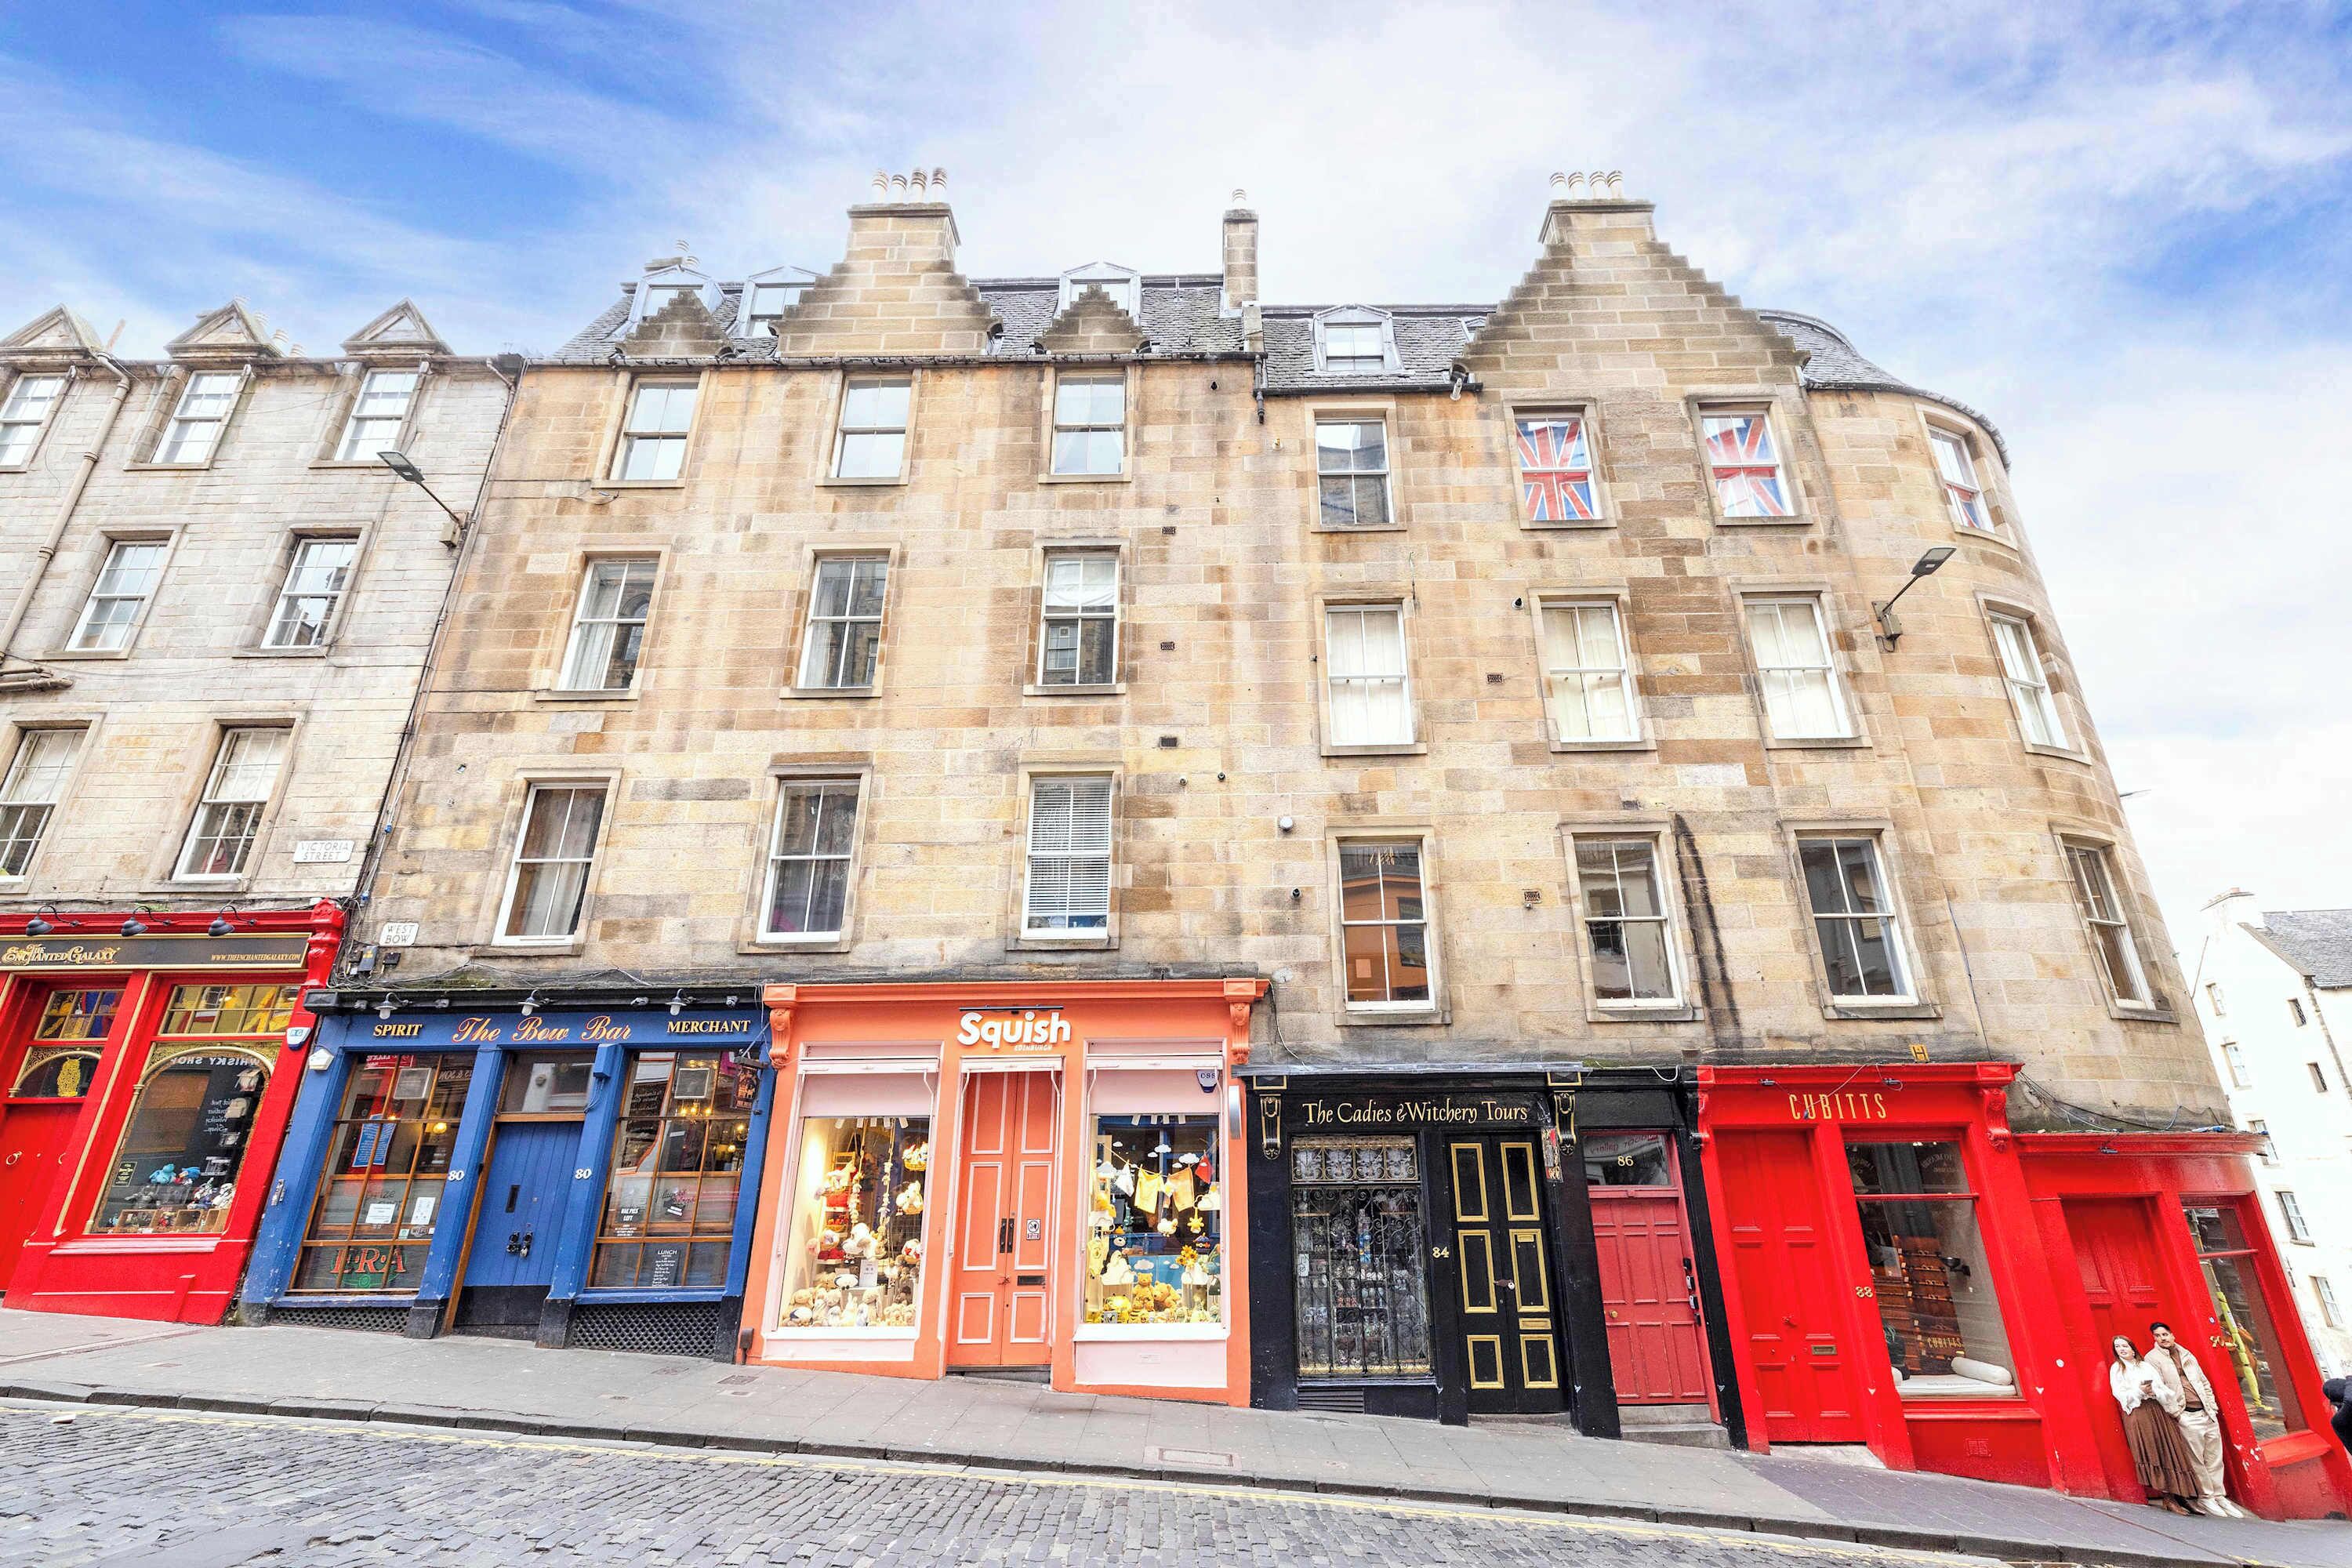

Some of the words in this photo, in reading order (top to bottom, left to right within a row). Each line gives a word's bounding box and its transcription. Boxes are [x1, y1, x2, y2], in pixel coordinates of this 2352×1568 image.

[300, 841, 350, 851] VICTORIA
[303, 851, 341, 860] STREET
[388, 924, 416, 934] WEST
[385, 935, 410, 944] BOW
[372, 1024, 423, 1036] SPIRIT
[452, 1017, 502, 1043] The
[512, 1016, 570, 1042] Bow
[580, 1015, 633, 1041] Bar
[666, 1020, 751, 1033] MERCHANT
[956, 1011, 1072, 1049] Squish
[1302, 1099, 1333, 1123] The
[1337, 1098, 1392, 1123] Cadies
[1404, 1098, 1479, 1124] Witchery
[1481, 1101, 1528, 1121] Tours
[1788, 1093, 1886, 1120] CUBITTS
[1617, 1156, 1634, 1167] 86
[448, 1170, 465, 1181] 80
[575, 1168, 593, 1180] 80
[1432, 1247, 1450, 1258] 84
[1856, 1287, 1874, 1298] 88
